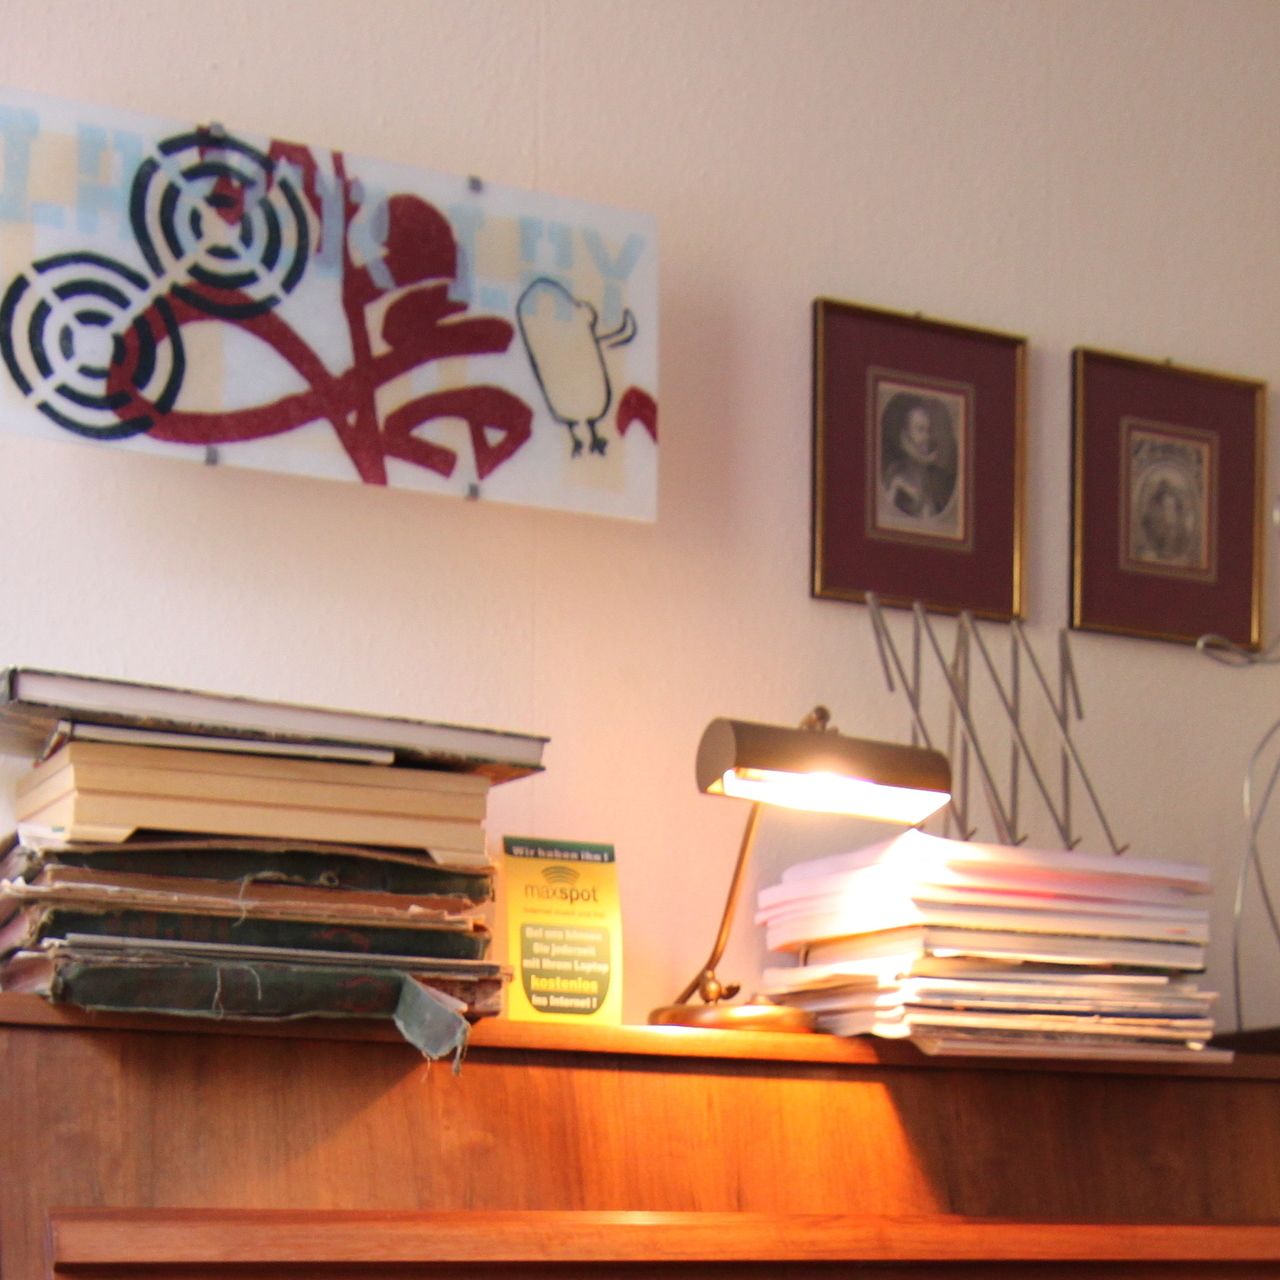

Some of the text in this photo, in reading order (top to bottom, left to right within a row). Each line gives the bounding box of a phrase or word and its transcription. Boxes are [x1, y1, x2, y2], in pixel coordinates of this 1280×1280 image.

[512, 846, 536, 857] Wir
[537, 847, 579, 861] haben
[524, 884, 599, 905] maxspot
[574, 959, 609, 974] Laptop
[531, 975, 598, 993] kostenlos
[548, 994, 591, 1009] Internet
